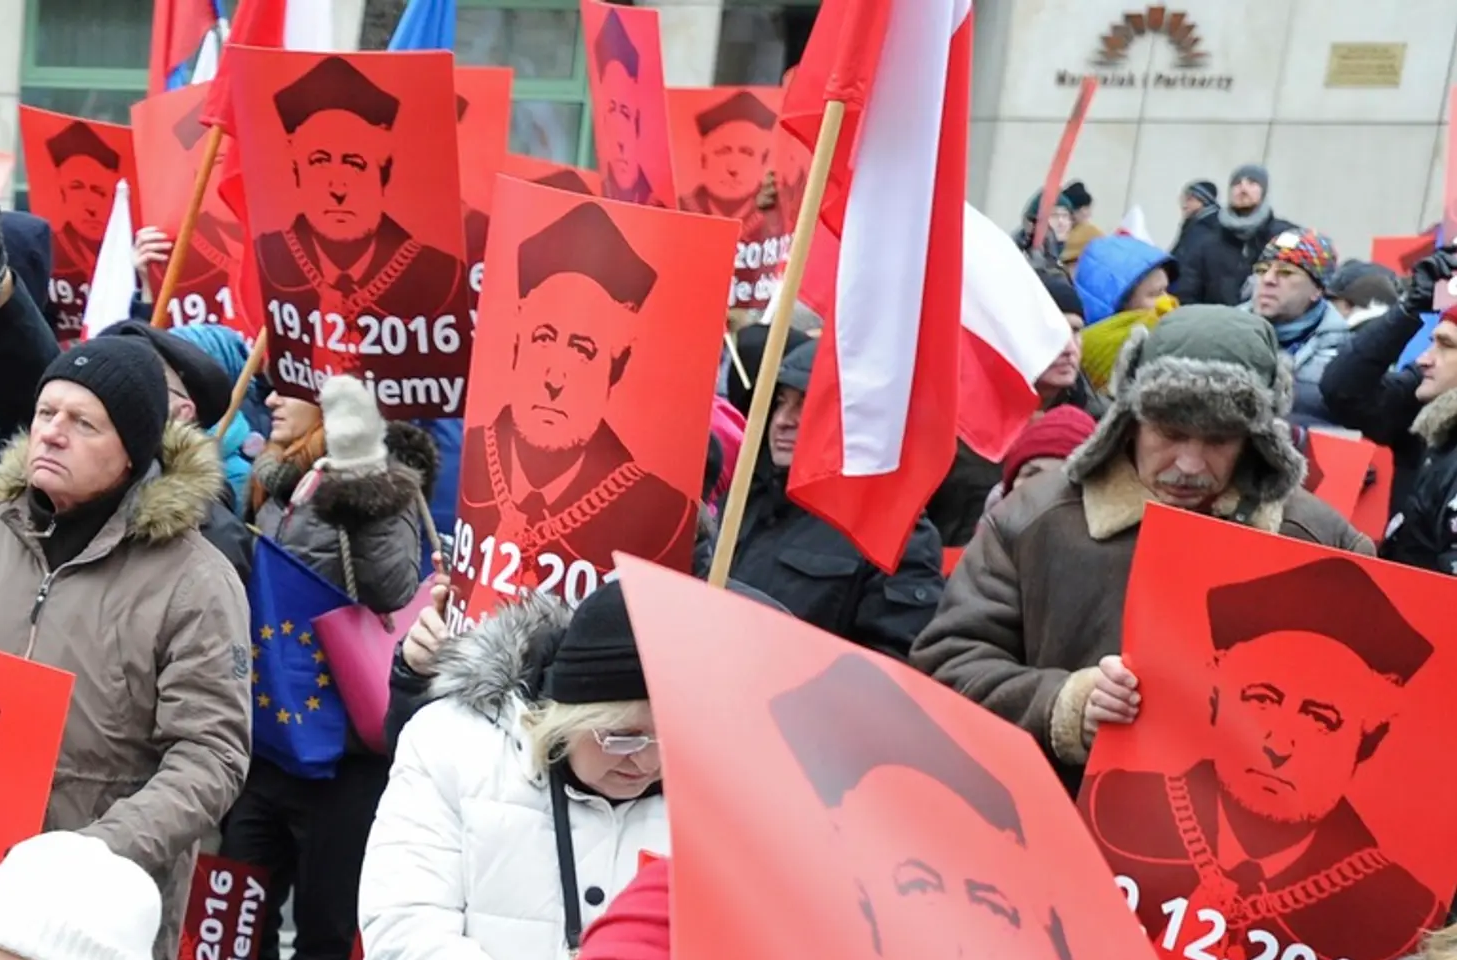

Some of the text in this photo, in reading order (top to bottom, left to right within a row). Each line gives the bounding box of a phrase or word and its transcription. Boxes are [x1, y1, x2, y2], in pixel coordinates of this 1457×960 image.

[268, 299, 460, 355] 19.12.2016
[278, 351, 465, 413] dzięjemy
[453, 518, 619, 610] 19.12.20
